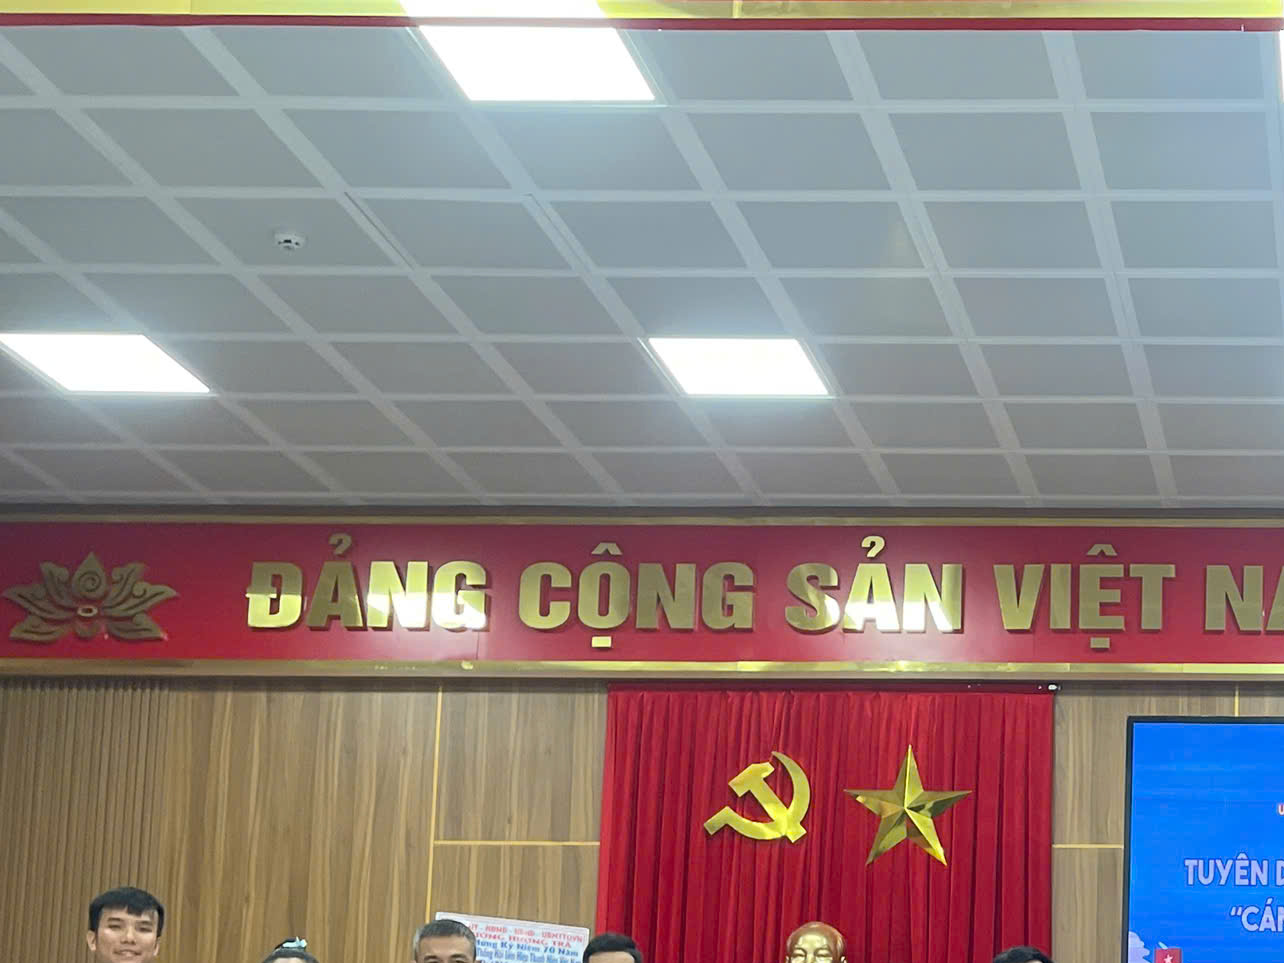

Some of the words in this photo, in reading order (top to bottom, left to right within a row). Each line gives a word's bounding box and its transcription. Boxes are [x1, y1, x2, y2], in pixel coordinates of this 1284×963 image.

[245, 533, 488, 630] ĐẢNG
[519, 541, 754, 648] CỘNG
[785, 535, 963, 633] SẢN
[993, 543, 1176, 649] VIỆT
[1184, 852, 1269, 886] TUYÊN
